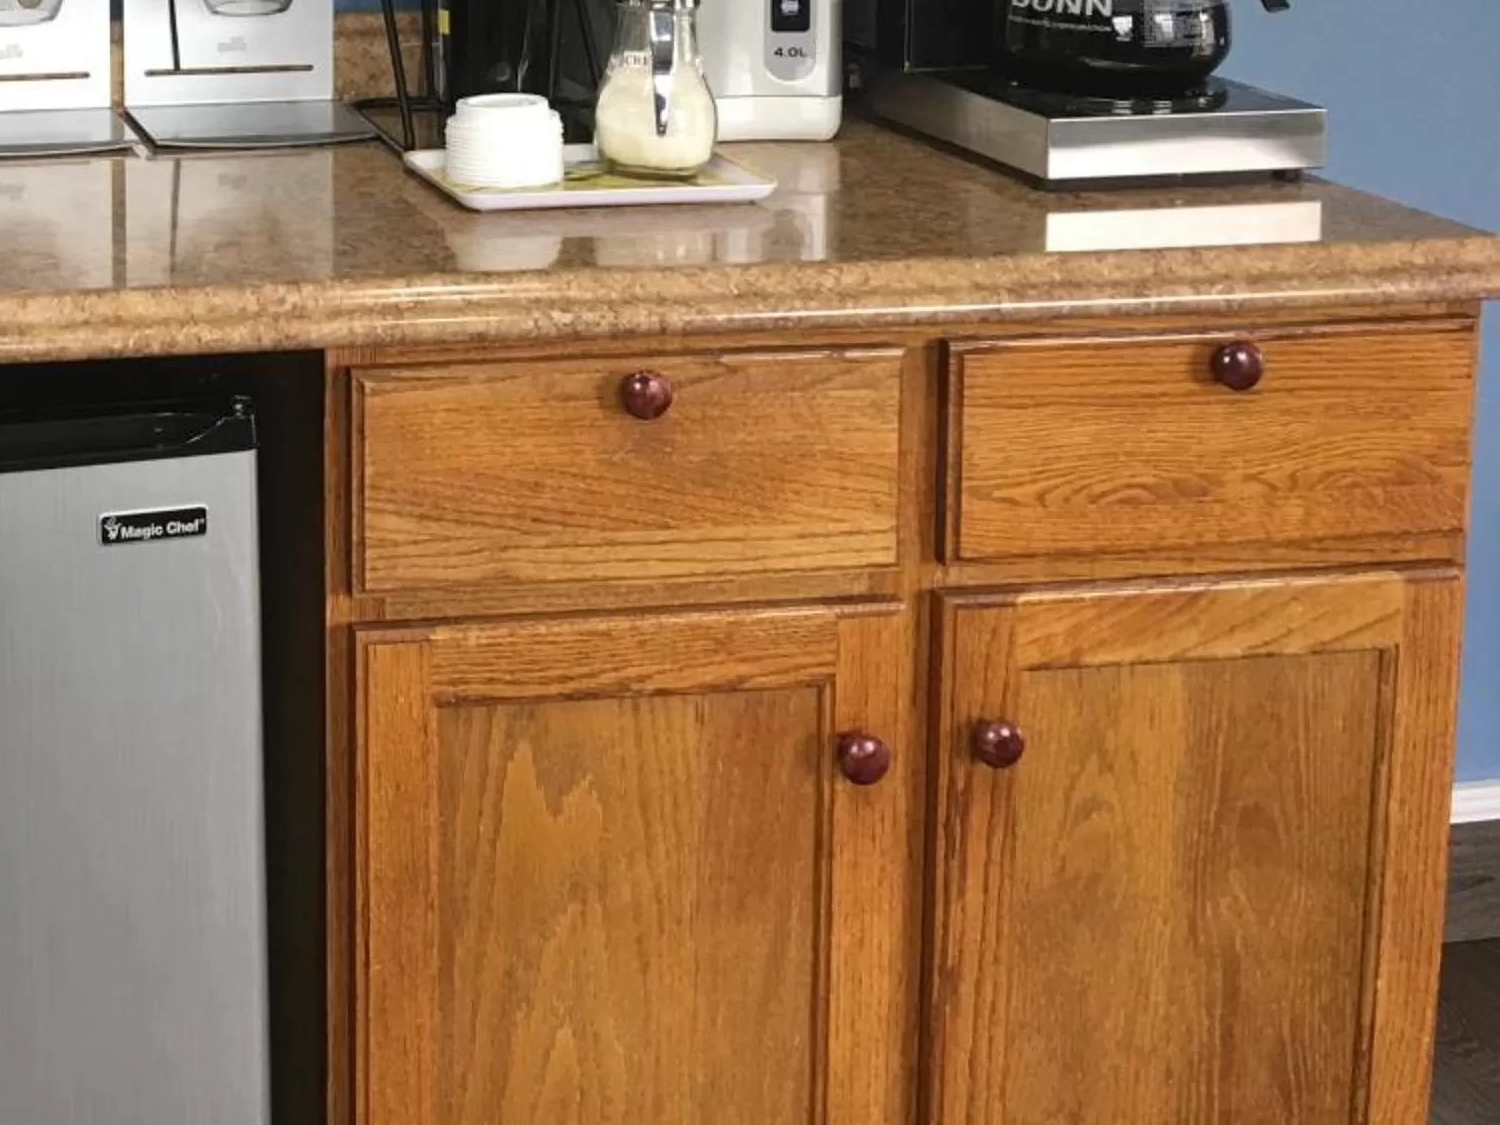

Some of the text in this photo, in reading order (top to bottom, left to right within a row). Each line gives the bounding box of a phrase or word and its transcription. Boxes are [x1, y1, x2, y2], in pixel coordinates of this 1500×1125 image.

[774, 46, 809, 58] 4.0L
[121, 518, 199, 540] Magic Chef
